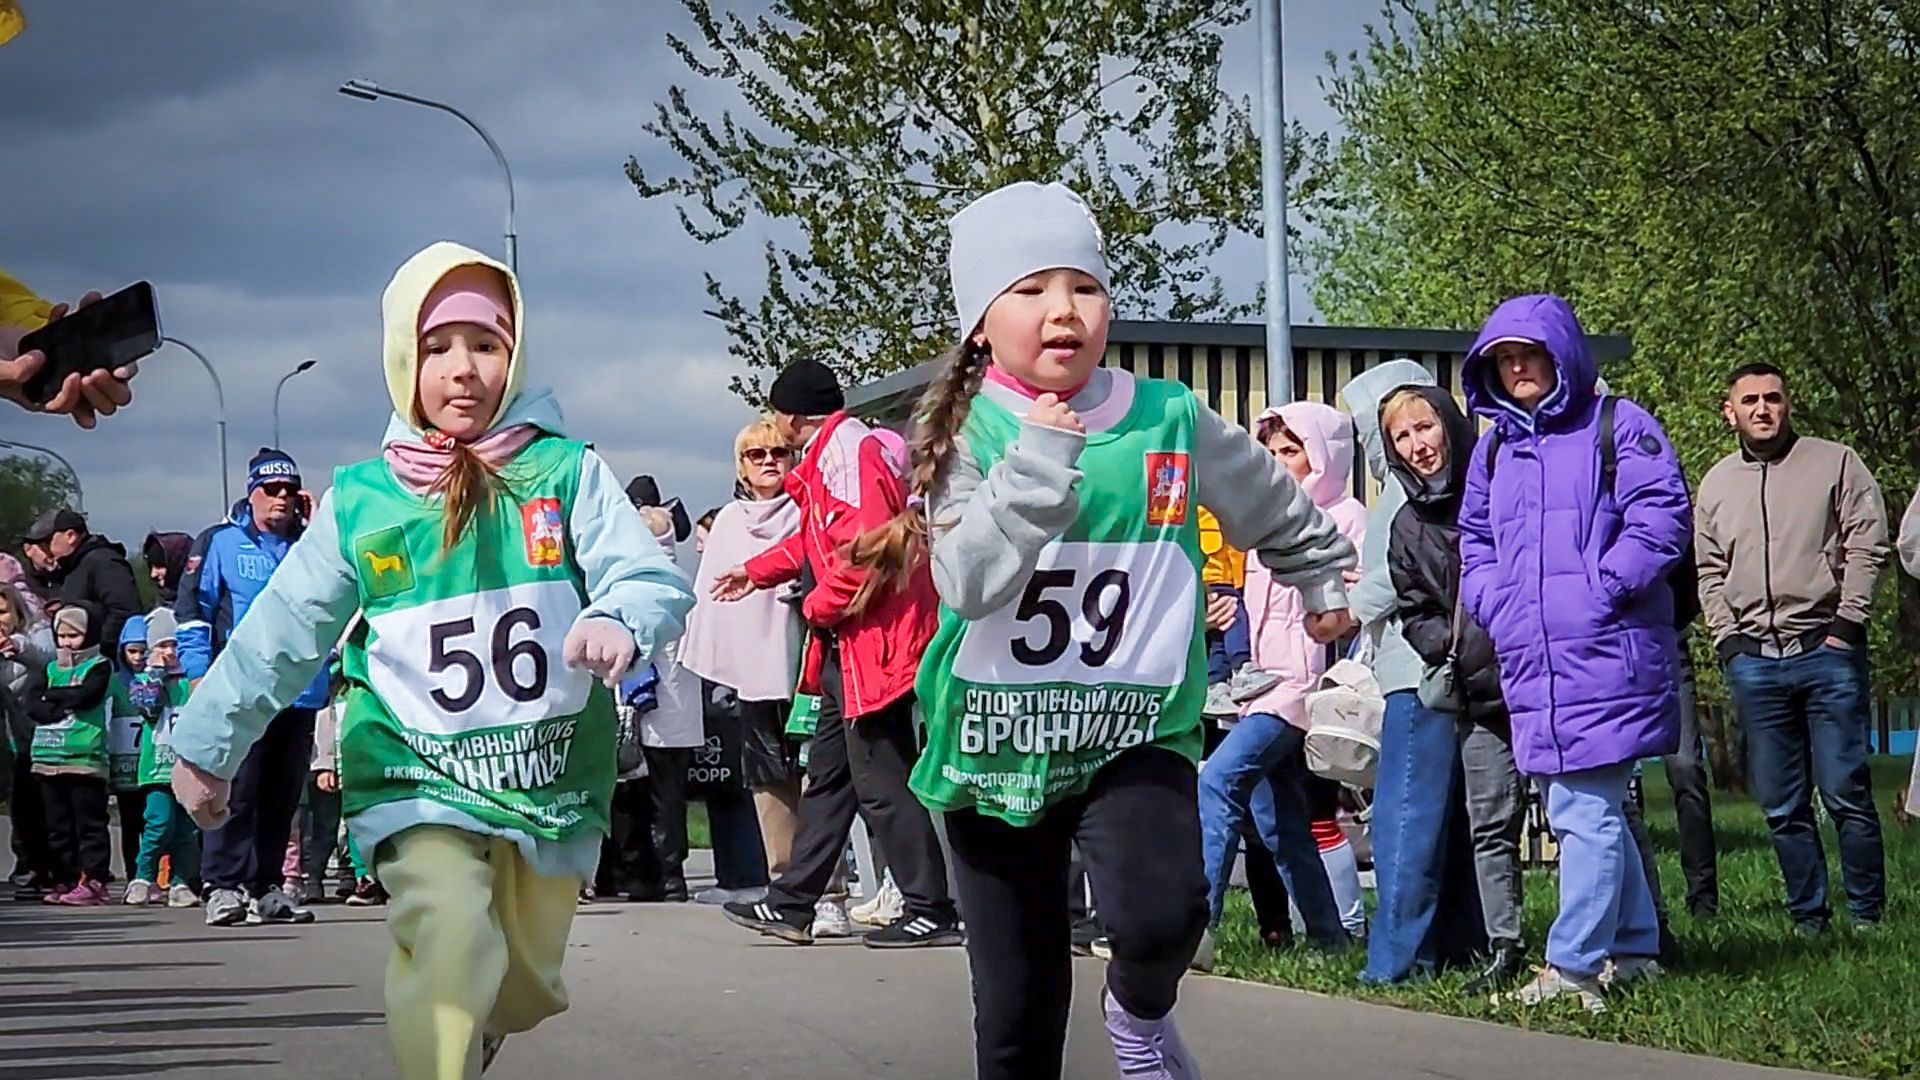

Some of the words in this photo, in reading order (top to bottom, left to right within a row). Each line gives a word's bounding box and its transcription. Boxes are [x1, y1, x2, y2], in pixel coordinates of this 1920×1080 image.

[1010, 569, 1130, 667] 59
[428, 607, 548, 714] 56
[537, 719, 577, 744] КЛУБ
[966, 686, 1106, 716] СПОРТИВНЫЙ
[1110, 690, 1161, 715] КЛУБ
